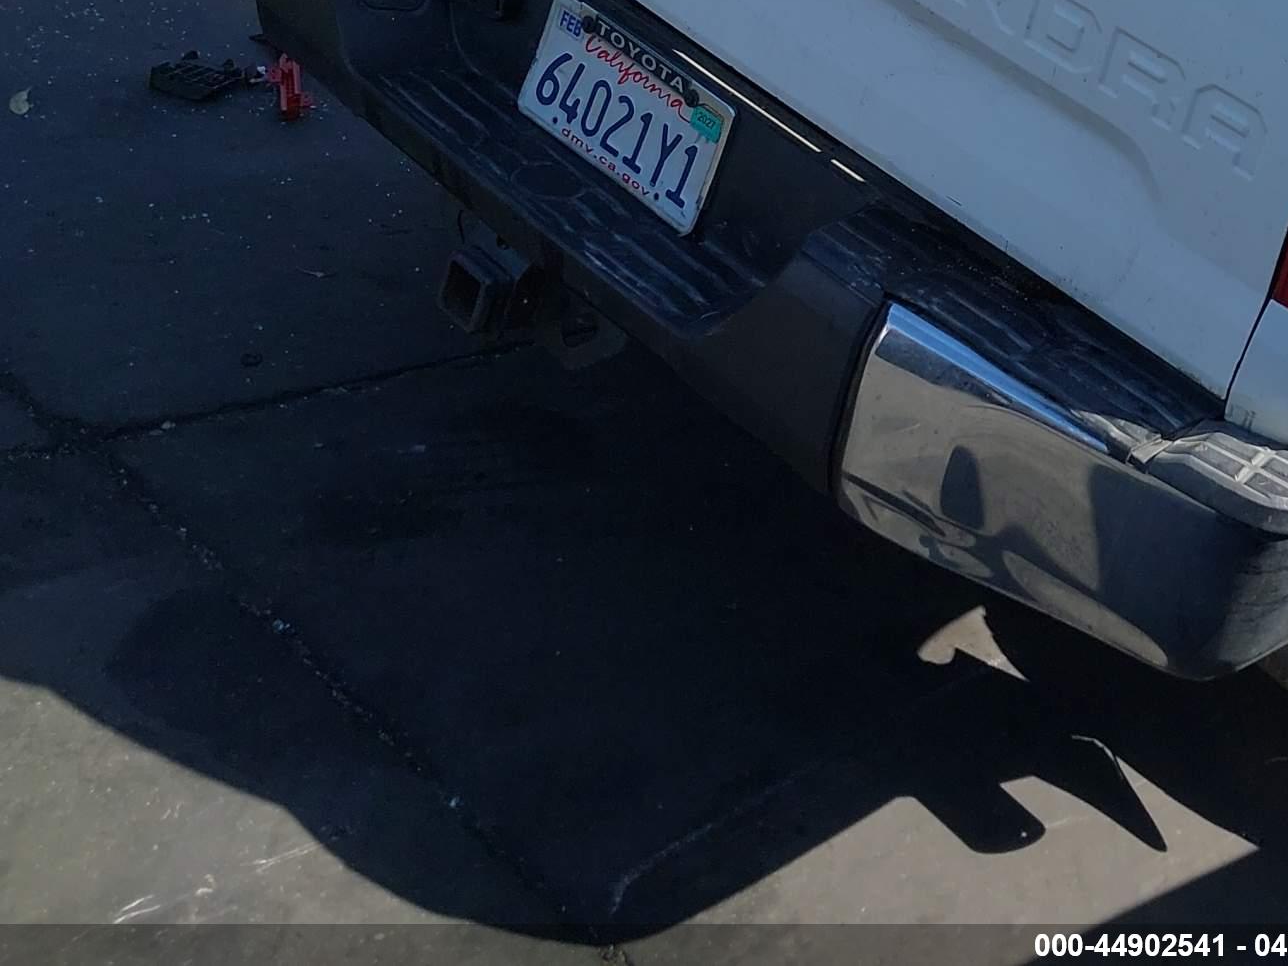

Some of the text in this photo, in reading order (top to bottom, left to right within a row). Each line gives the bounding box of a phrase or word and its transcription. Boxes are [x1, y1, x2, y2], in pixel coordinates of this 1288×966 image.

[560, 10, 583, 37] FEB
[598, 20, 684, 93] TOYOTA
[585, 35, 691, 123] California
[535, 52, 698, 209] 64021Y1
[561, 127, 650, 197] dmv.ca.gov
